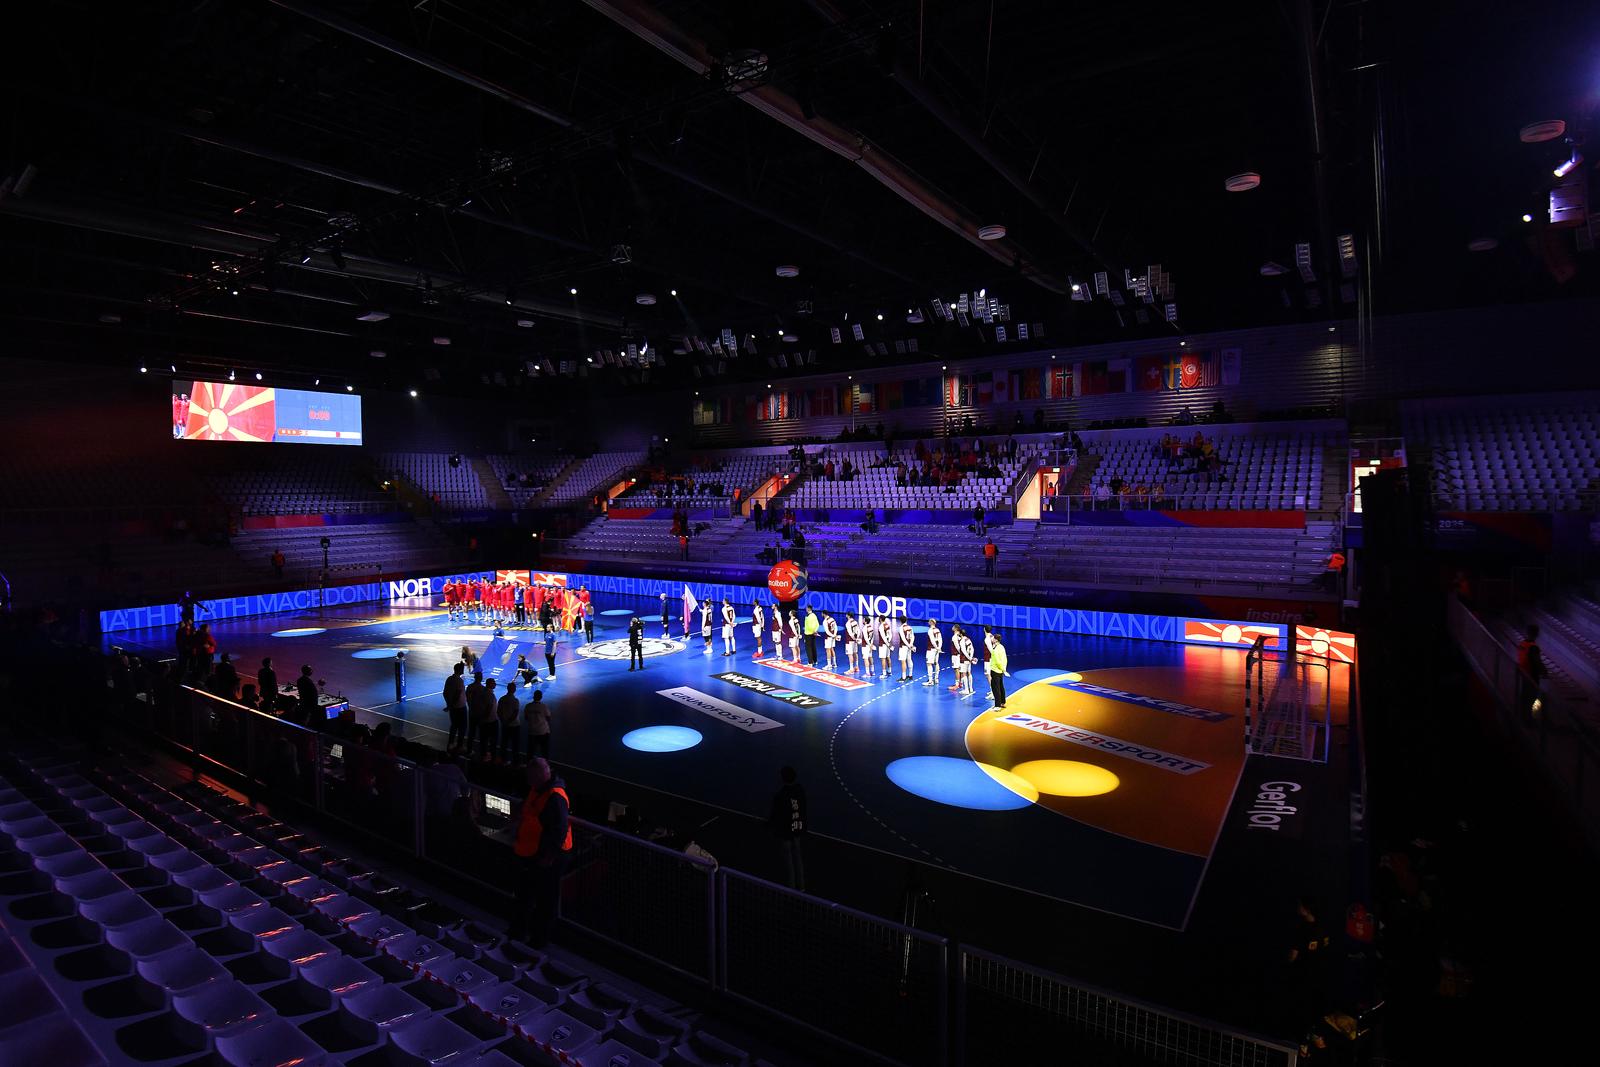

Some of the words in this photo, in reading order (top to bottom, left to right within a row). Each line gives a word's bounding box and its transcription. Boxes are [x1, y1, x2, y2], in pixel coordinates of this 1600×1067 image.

[390, 578, 431, 598] NOR
[596, 576, 635, 595] MATH
[640, 579, 681, 598] MATH
[858, 594, 906, 617] NOR
[671, 692, 738, 720] GRUNDFOS
[1026, 720, 1204, 772] INTERSPORT
[1246, 781, 1302, 831] Gerflor
